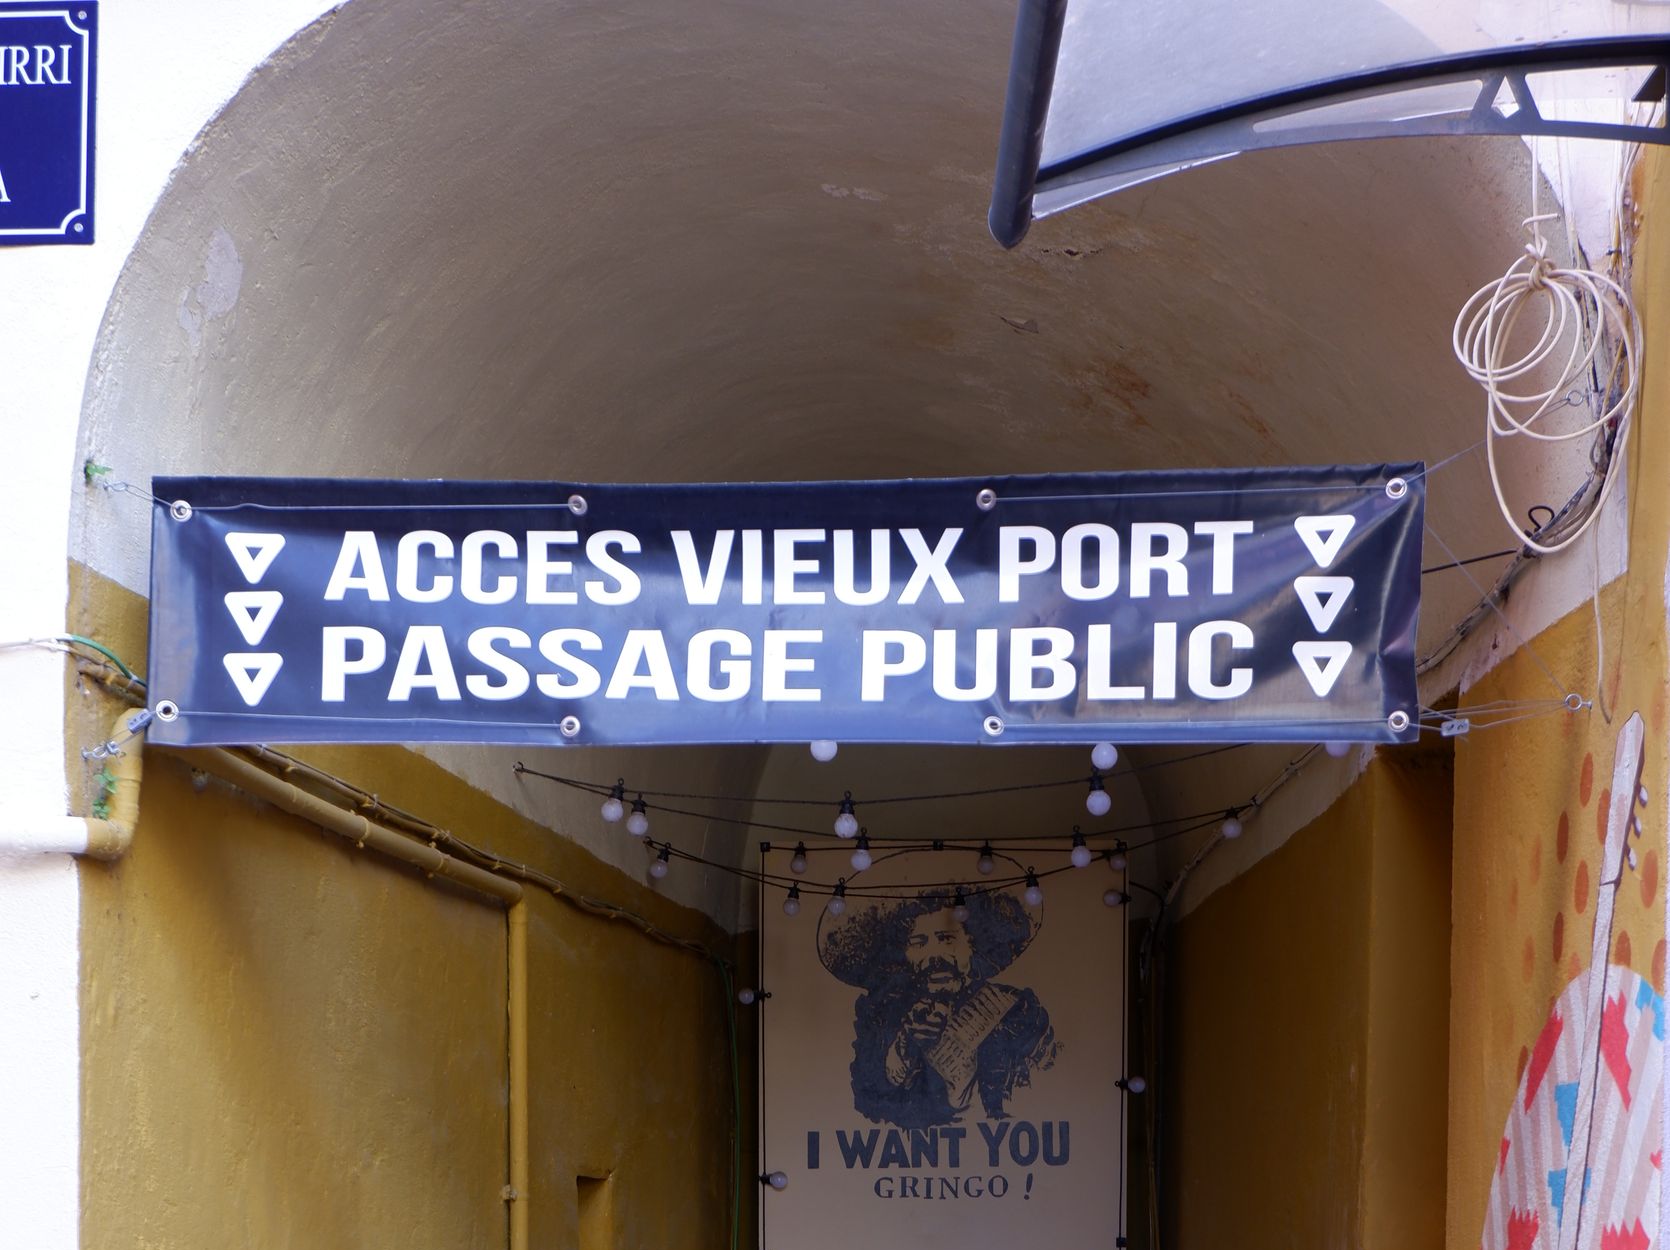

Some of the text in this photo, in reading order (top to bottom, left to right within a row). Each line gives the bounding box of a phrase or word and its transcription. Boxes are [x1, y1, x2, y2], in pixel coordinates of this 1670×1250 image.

[323, 520, 1254, 606] ACCES VIEUX PORT
[321, 620, 1254, 702] PASSAGE PUBLIC
[806, 1120, 1070, 1169] I WANT YOU
